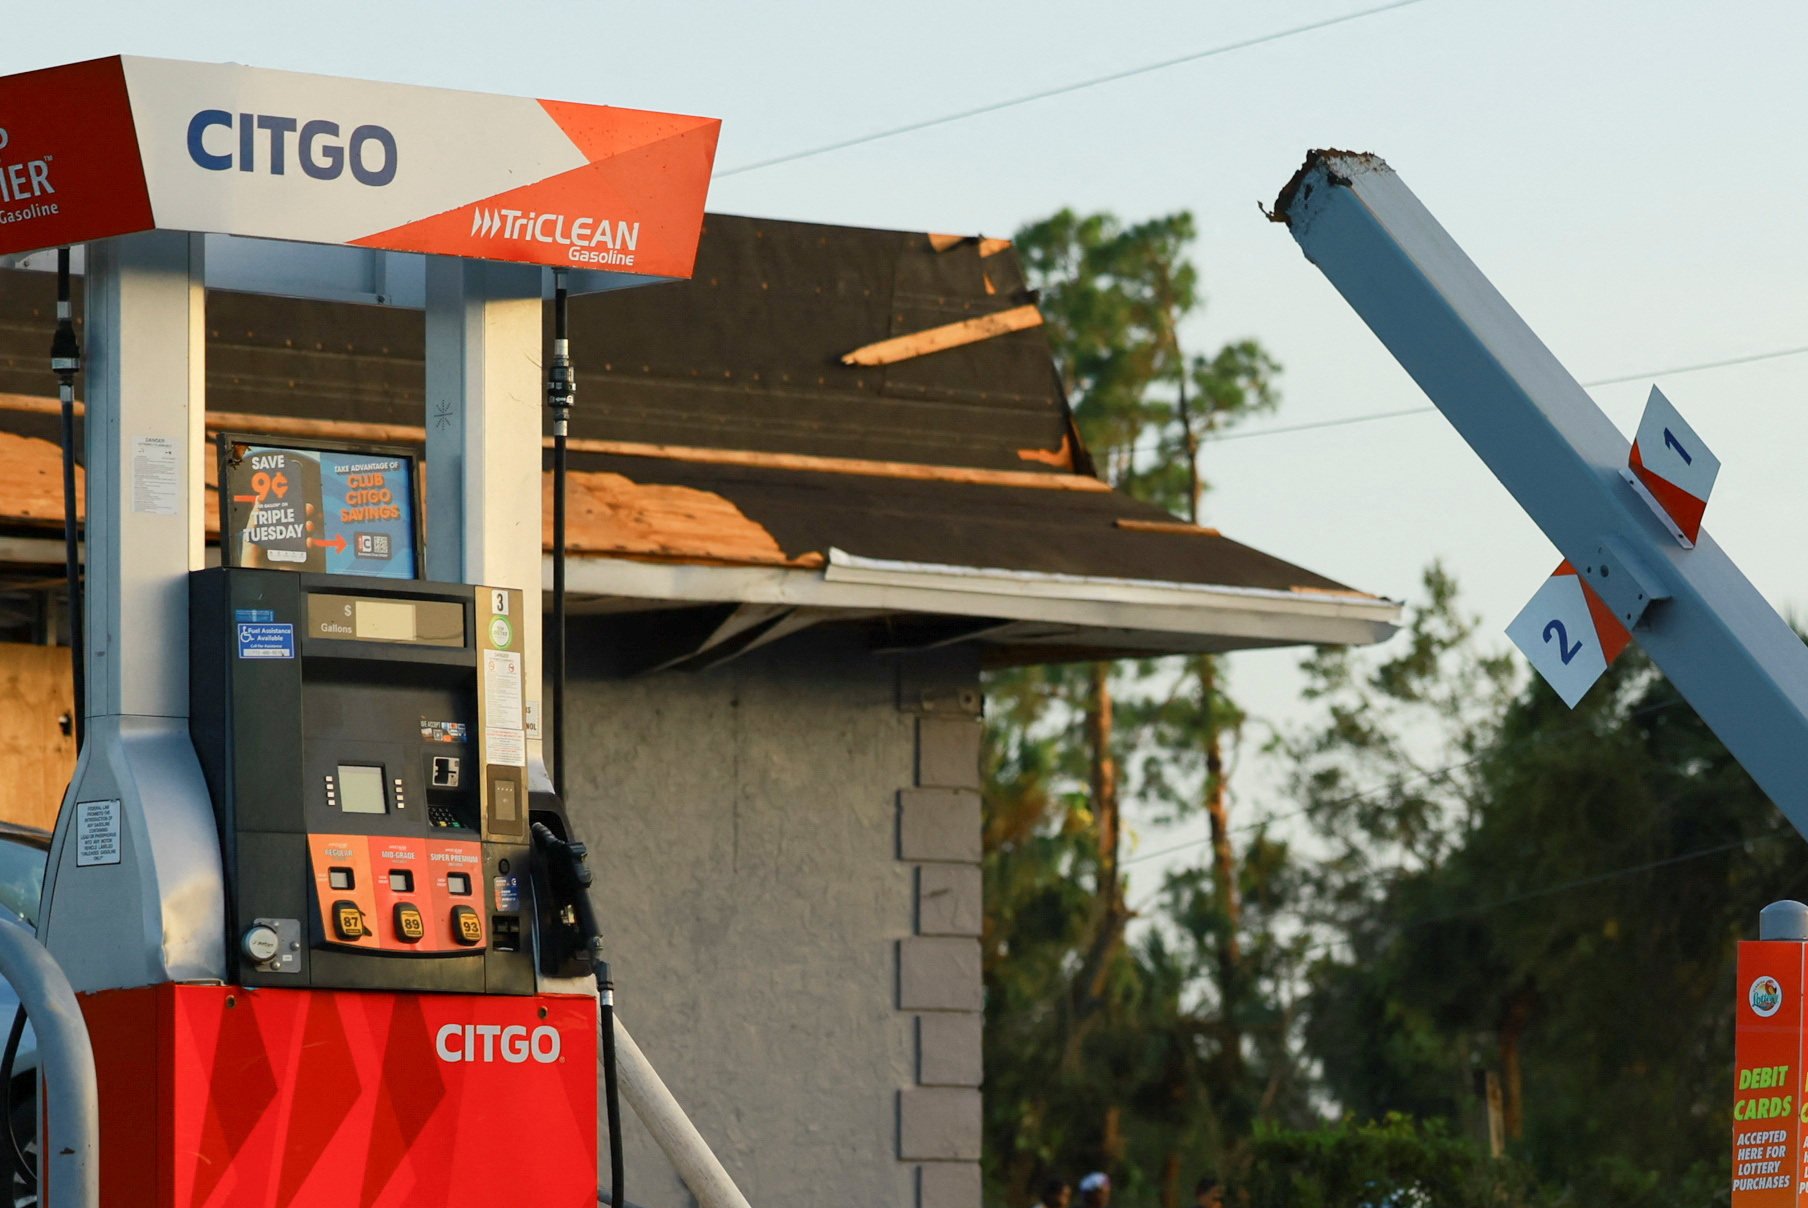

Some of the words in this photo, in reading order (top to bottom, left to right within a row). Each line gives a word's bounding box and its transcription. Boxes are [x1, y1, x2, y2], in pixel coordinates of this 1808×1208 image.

[186, 108, 398, 187] CITGO
[0, 160, 55, 202] IER
[0, 203, 59, 224] Gasoline
[500, 208, 640, 251] TriCLEAN
[568, 246, 635, 266] Gasoline
[1663, 427, 1693, 467] 1
[252, 454, 285, 470] SAVE
[334, 465, 350, 473] TAKE
[350, 462, 388, 472] ADVANTAGE
[251, 471, 289, 502] 9¢
[347, 472, 385, 488] CLUB
[345, 488, 392, 506] CITGO
[252, 508, 295, 525] TRIPLE
[340, 505, 400, 523] SAVINGS
[243, 524, 304, 542] TUESDAY
[496, 593, 504, 612] 3
[320, 622, 352, 634] Gallons
[1542, 619, 1584, 666] 2
[382, 851, 416, 859] MID-GRADE
[431, 853, 450, 862] SUPER
[450, 854, 479, 863] PREMIUM
[344, 917, 358, 928] 87
[404, 919, 420, 930] 89
[464, 922, 479, 932] 93
[1752, 992, 1778, 1008] Lottery
[436, 1023, 560, 1064] CITGO
[1738, 1065, 1789, 1090] DEBIT
[1734, 1095, 1792, 1121] CARDS
[1737, 1130, 1787, 1146] ACCEPTED
[1737, 1147, 1764, 1160] HERE
[1766, 1145, 1786, 1158] FOR
[1738, 1161, 1781, 1176] LOTTERY
[1733, 1175, 1790, 1192] PURCHASES
